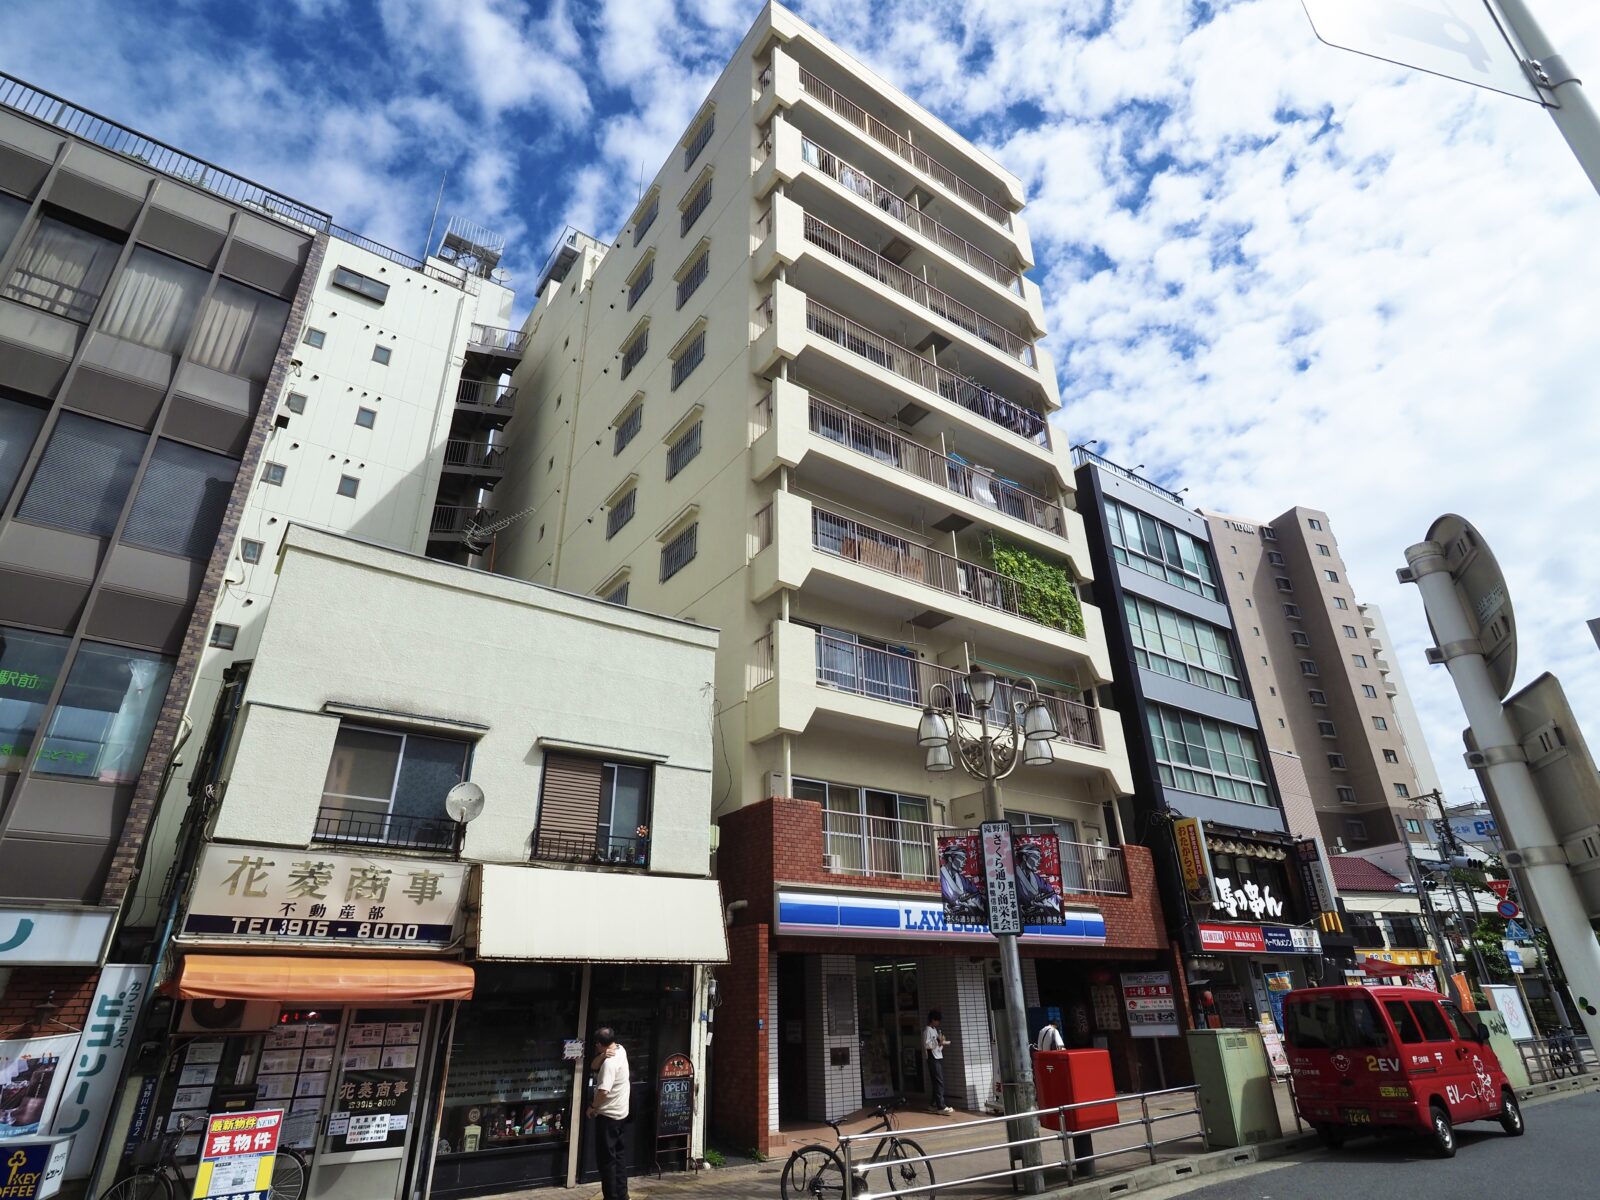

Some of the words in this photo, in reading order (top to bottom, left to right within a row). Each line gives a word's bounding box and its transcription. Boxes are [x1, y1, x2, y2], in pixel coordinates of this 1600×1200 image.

[983, 823, 1010, 833] 滝野川
[1178, 826, 1195, 878] おたからや
[219, 855, 446, 905] 花菱商事
[993, 834, 1012, 931] さくら通り商栄会
[279, 902, 386, 921] 不動産部
[1007, 881, 1019, 930] 東日本銀行
[1223, 930, 1263, 942] OTAKARAYA
[113, 981, 143, 1048] カフェテラス
[58, 991, 126, 1134] ピコリーノ
[340, 1081, 409, 1099] 花菱商事
[664, 1081, 688, 1093] OPEN
[1446, 1084, 1460, 1105] EV
[211, 1116, 256, 1133] 最新物件
[212, 1131, 272, 1154] 売物件
[13, 1173, 41, 1185] KEY
